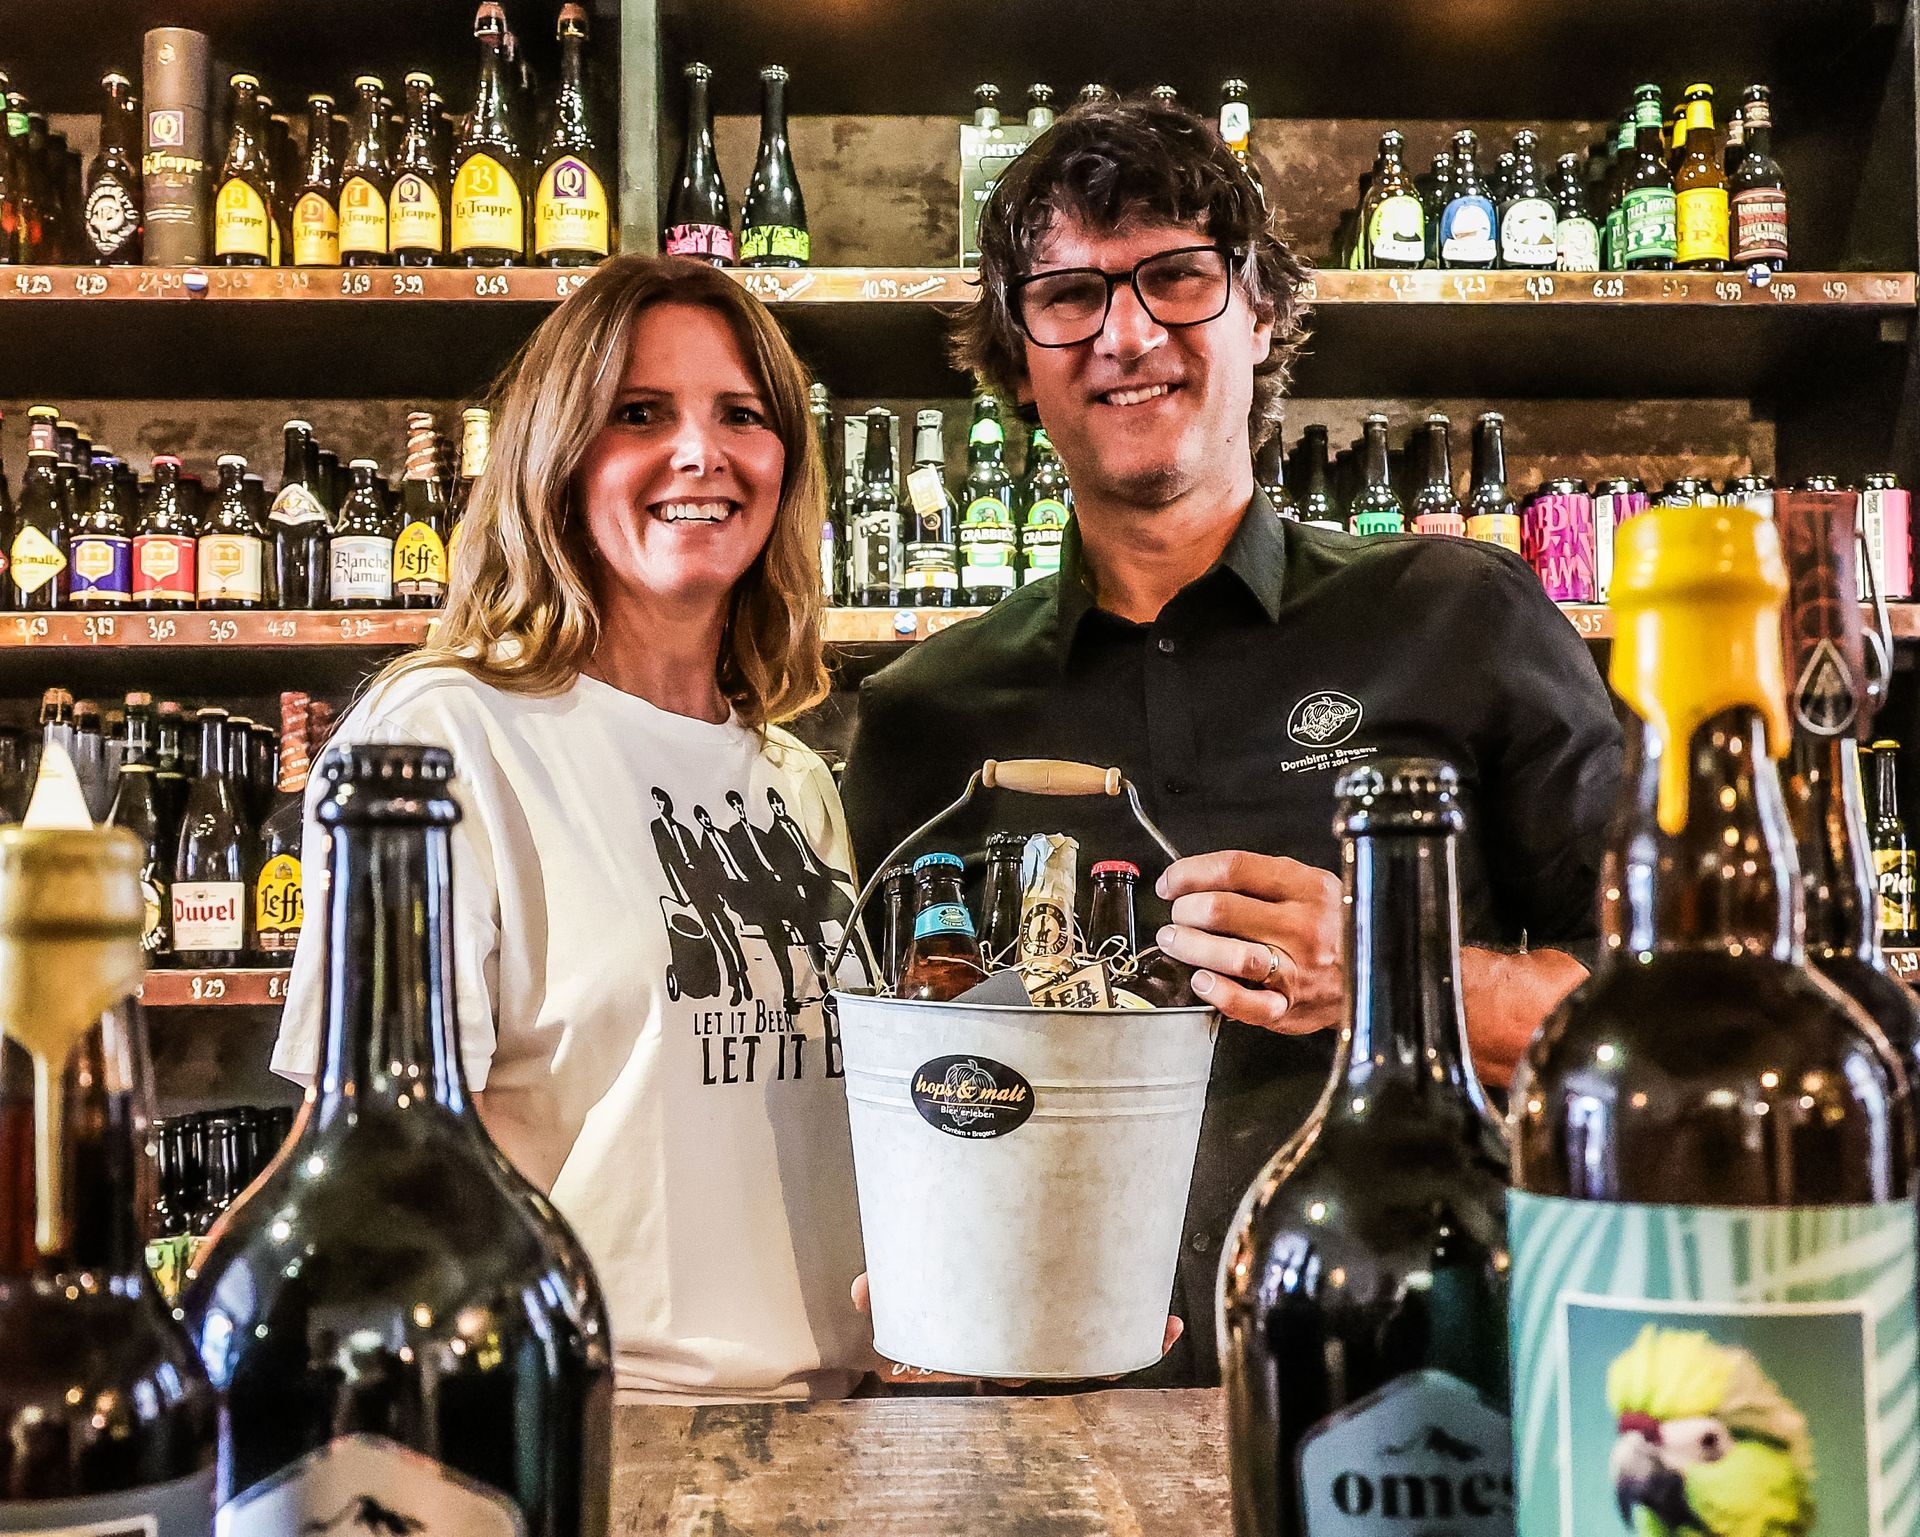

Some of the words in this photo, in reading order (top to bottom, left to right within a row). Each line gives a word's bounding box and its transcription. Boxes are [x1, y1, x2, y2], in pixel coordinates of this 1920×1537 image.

[150, 150, 203, 175] Trappe
[556, 165, 583, 200] Q
[226, 211, 263, 228] Trappe
[348, 210, 385, 226] Trappe
[400, 205, 437, 221] Trappe
[468, 199, 513, 218] Trappe
[556, 202, 601, 221] Trappe
[1627, 223, 1677, 253] IPA
[334, 551, 389, 571] Blanche
[399, 543, 439, 575] Leffe
[343, 567, 387, 584] Namur
[173, 897, 236, 923] Duvel
[694, 1011, 723, 1036] LET
[731, 1011, 747, 1034] IT
[701, 1034, 762, 1086] LET
[776, 1033, 808, 1081] IT
[914, 1073, 956, 1100] hops
[956, 1079, 977, 1100] &
[980, 1083, 1027, 1102] malt
[940, 1105, 957, 1116] Bier
[960, 1108, 995, 1119] erleben
